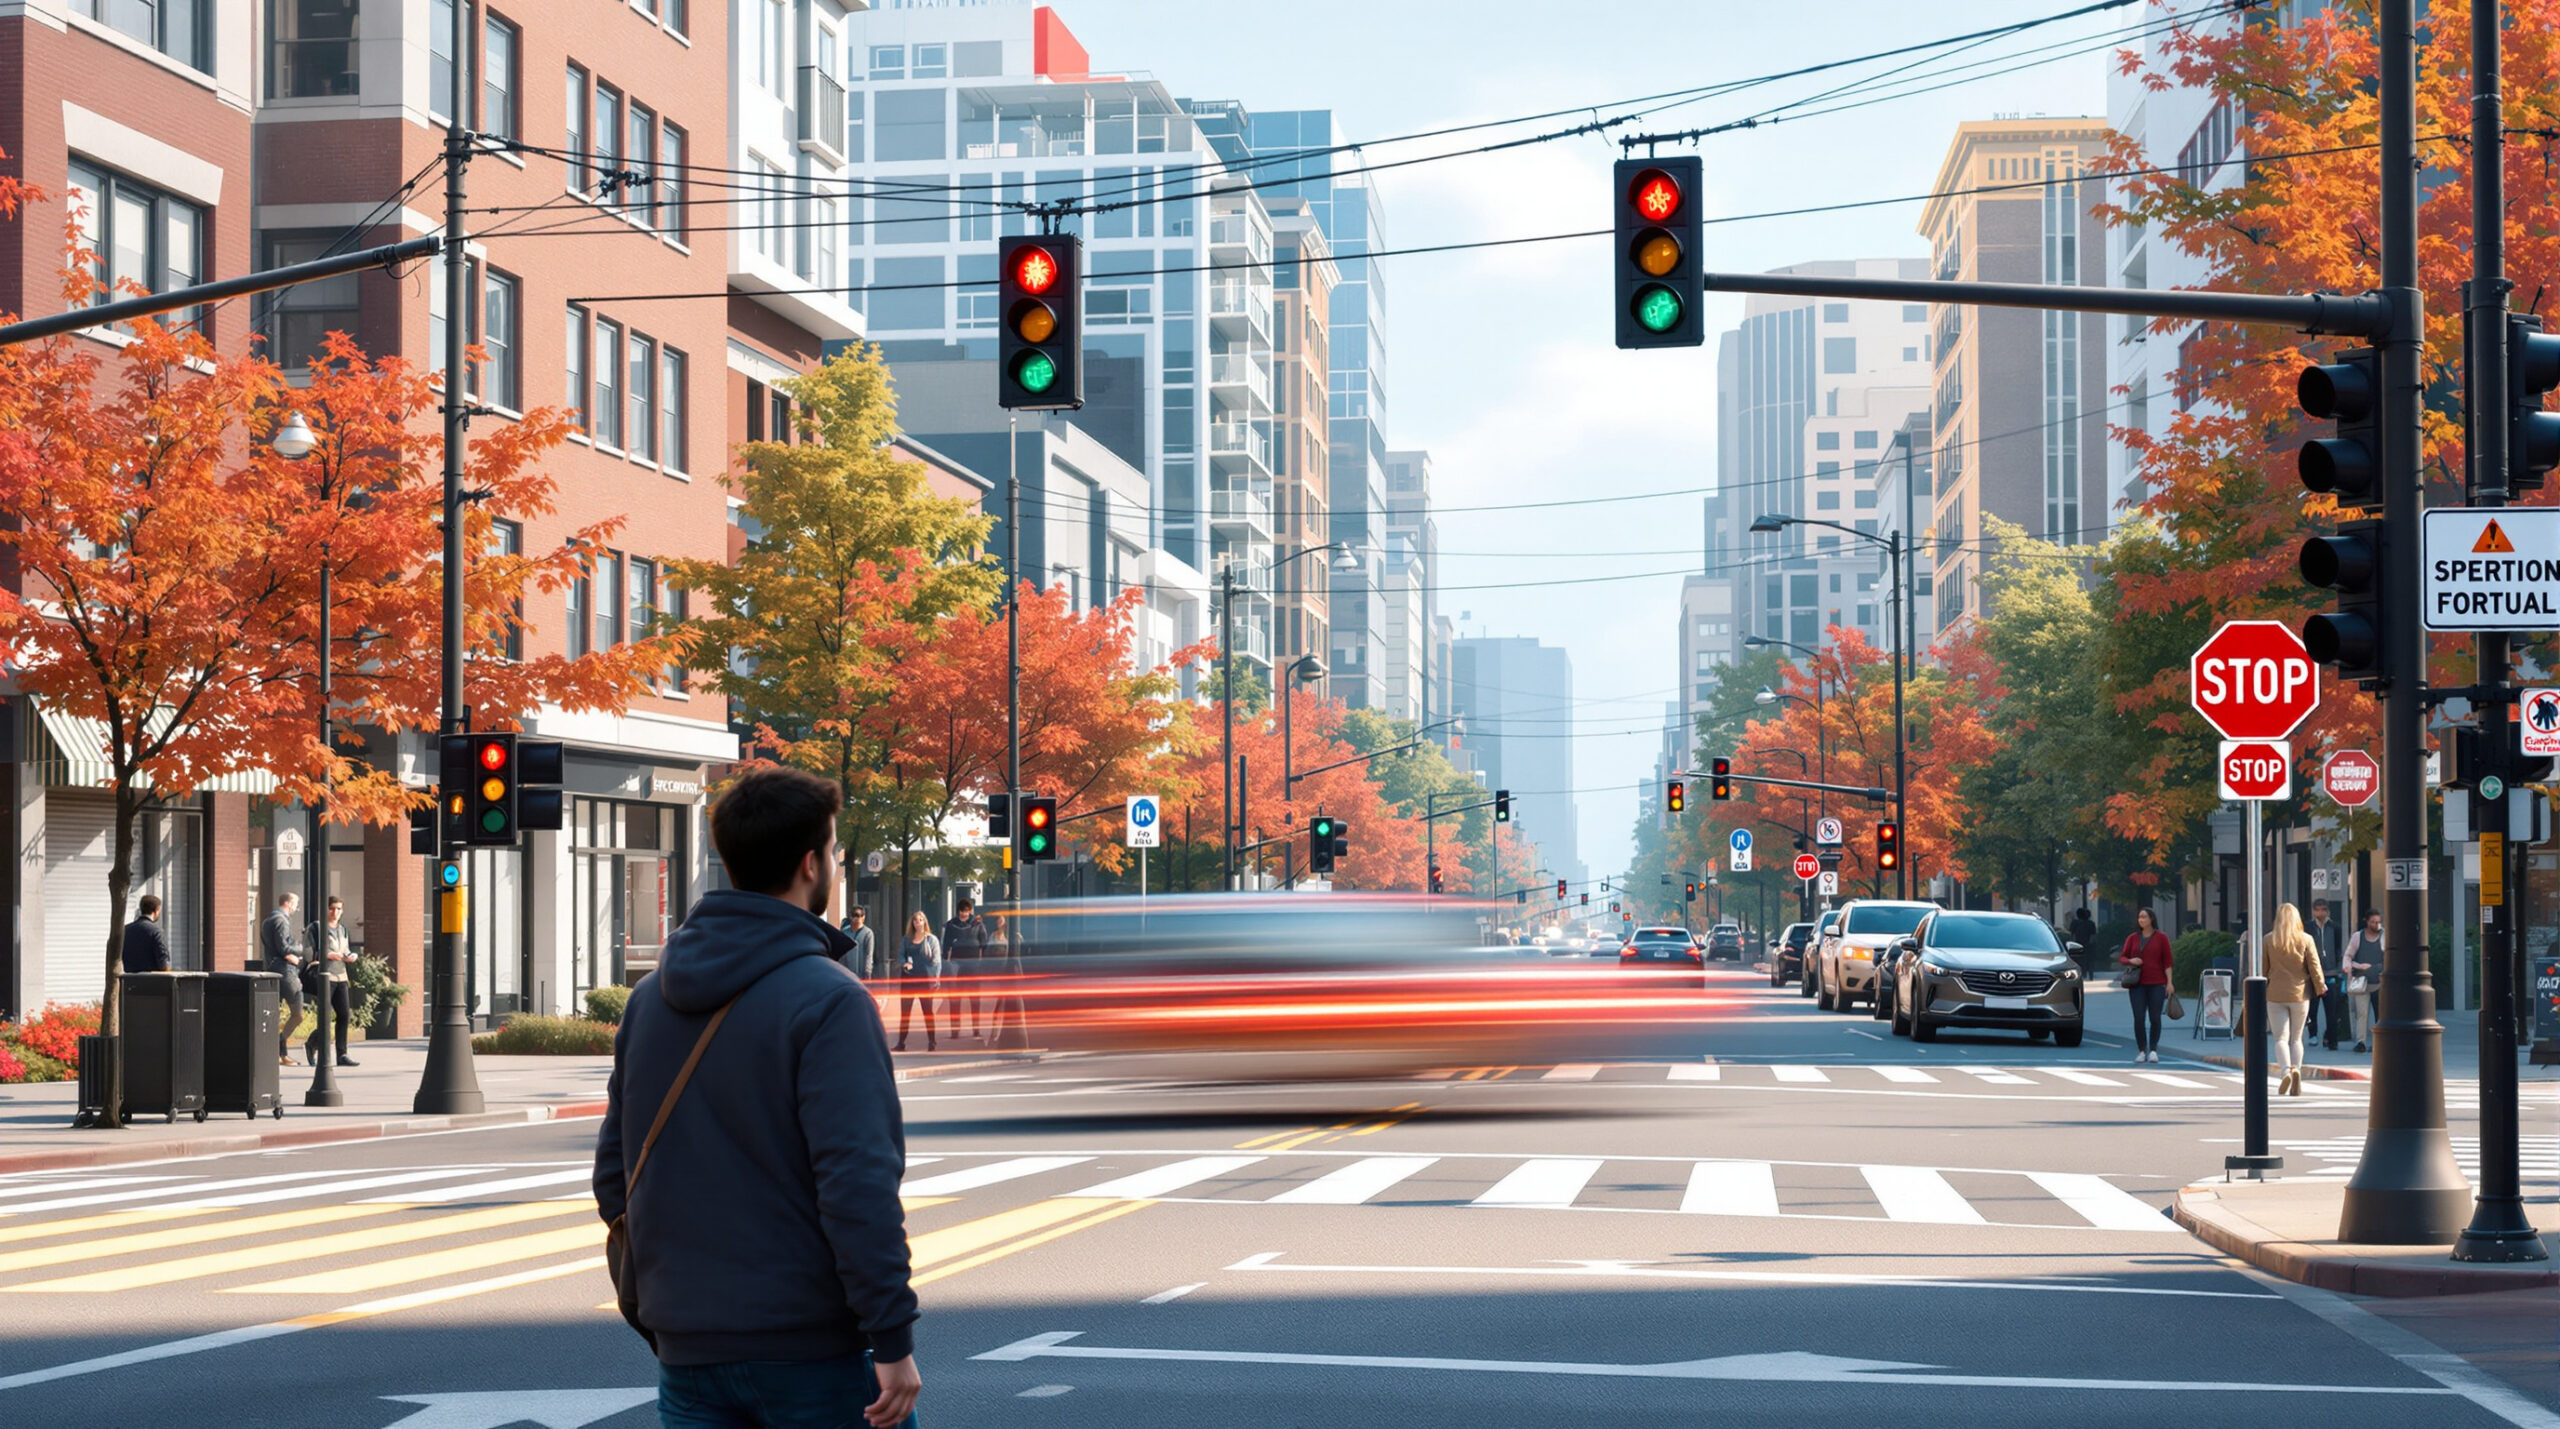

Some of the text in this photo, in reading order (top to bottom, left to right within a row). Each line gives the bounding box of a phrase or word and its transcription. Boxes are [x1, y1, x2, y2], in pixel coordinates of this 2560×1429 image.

[2435, 559, 2560, 582] SPERTION
[2438, 592, 2557, 614] FORTUAL
[2201, 657, 2309, 705] STOP
[2228, 758, 2282, 782] STOP
